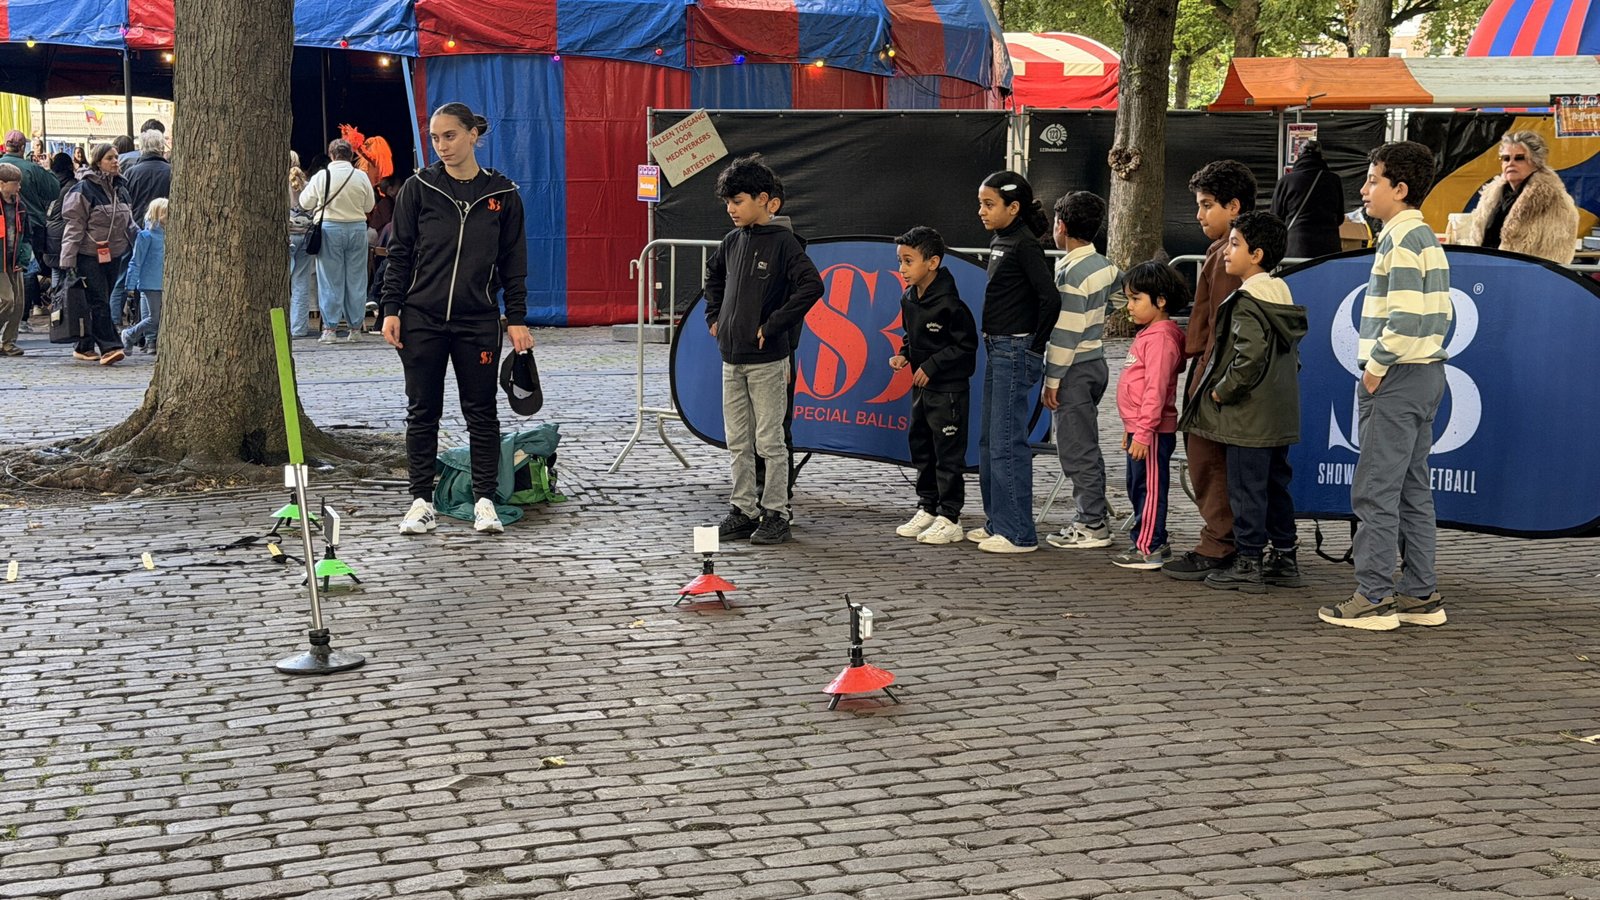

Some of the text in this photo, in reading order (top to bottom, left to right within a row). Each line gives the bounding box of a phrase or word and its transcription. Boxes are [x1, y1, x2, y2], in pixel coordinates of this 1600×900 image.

[652, 112, 706, 148] ALLEEN TOEGANG
[673, 131, 693, 145] VOOR
[666, 132, 711, 163] MEDEWERKERS
[682, 153, 716, 176] ARTIESTEN
[794, 406, 907, 430] PECIAL BALLS
[1430, 468, 1476, 493] ETBALL
